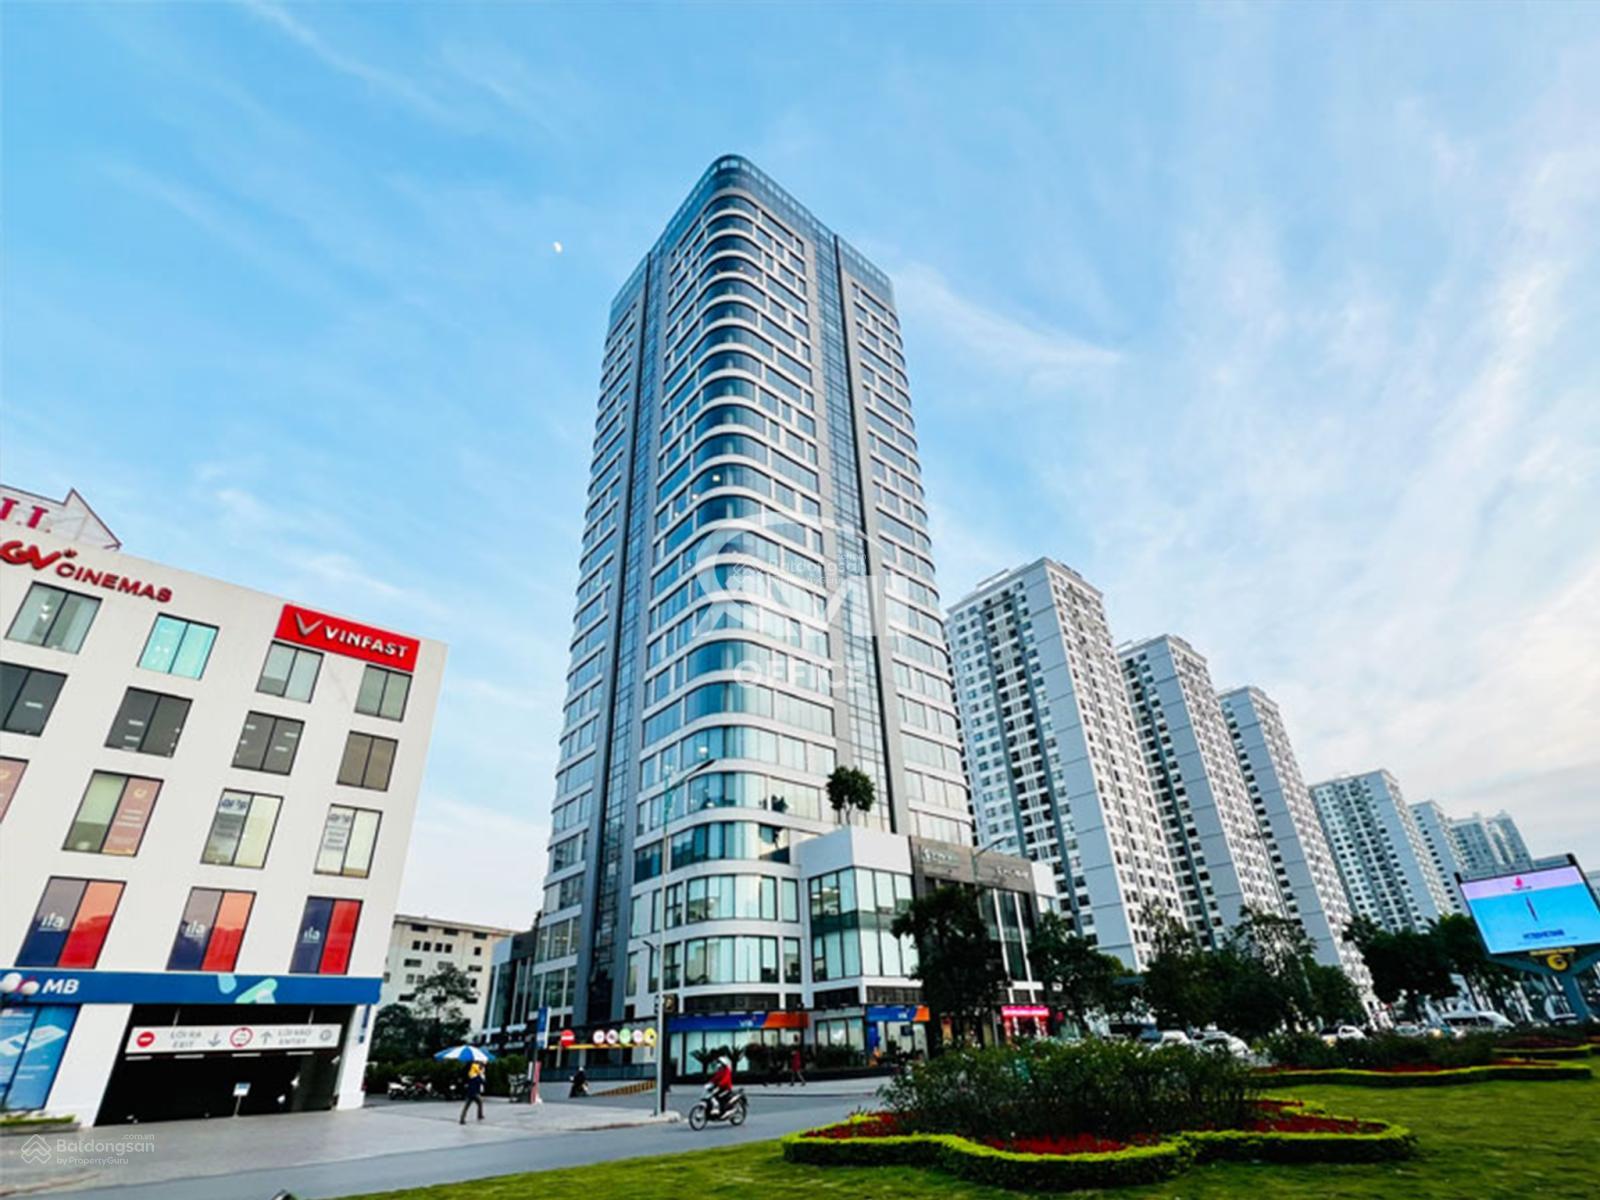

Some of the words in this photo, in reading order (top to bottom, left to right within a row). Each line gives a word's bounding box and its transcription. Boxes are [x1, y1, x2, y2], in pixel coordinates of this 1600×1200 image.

[55, 562, 173, 603] CINEMAS
[325, 625, 409, 658] VINFAST
[42, 978, 80, 995] MB
